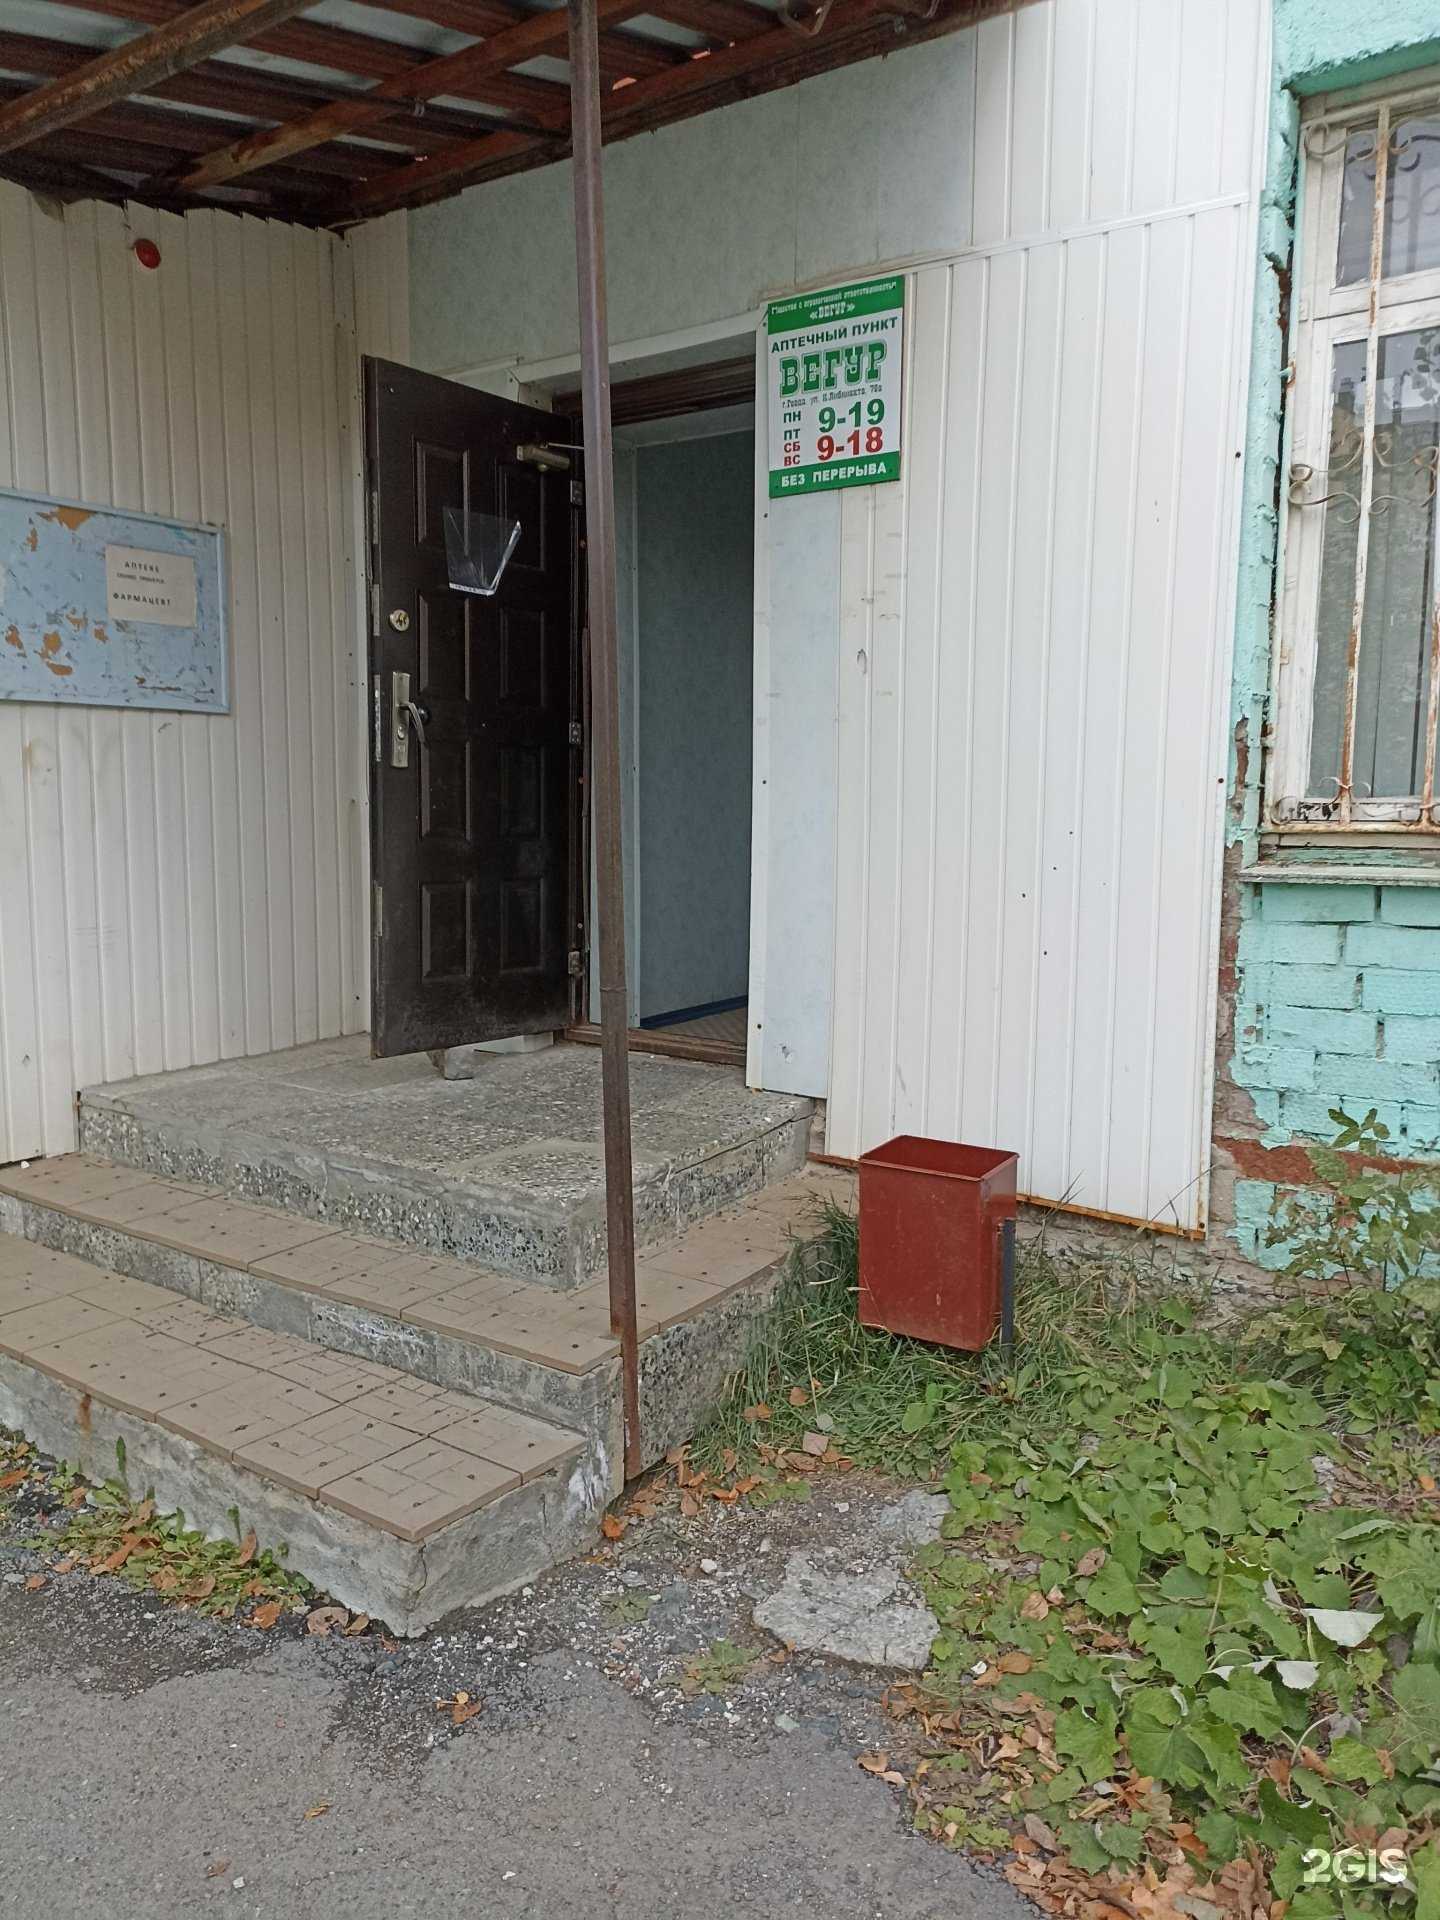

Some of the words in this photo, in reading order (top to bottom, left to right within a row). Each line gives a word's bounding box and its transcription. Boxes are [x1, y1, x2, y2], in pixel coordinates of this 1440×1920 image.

[771, 325, 848, 353] АПТЕЧНЫЙ
[852, 316, 898, 337] ПУНКТ
[780, 340, 887, 397] ВЕГУР
[784, 411, 801, 423] ПН
[818, 399, 885, 433] 9-19
[784, 428, 801, 441] ПТ
[817, 427, 883, 461] 9-18
[784, 441, 801, 453] СБ
[784, 454, 801, 467] ВС
[781, 474, 805, 488] БЕЗ
[813, 462, 887, 483] ПЕРЕРЫВА
[113, 593, 170, 606] ФАРМАЦЕВТ
